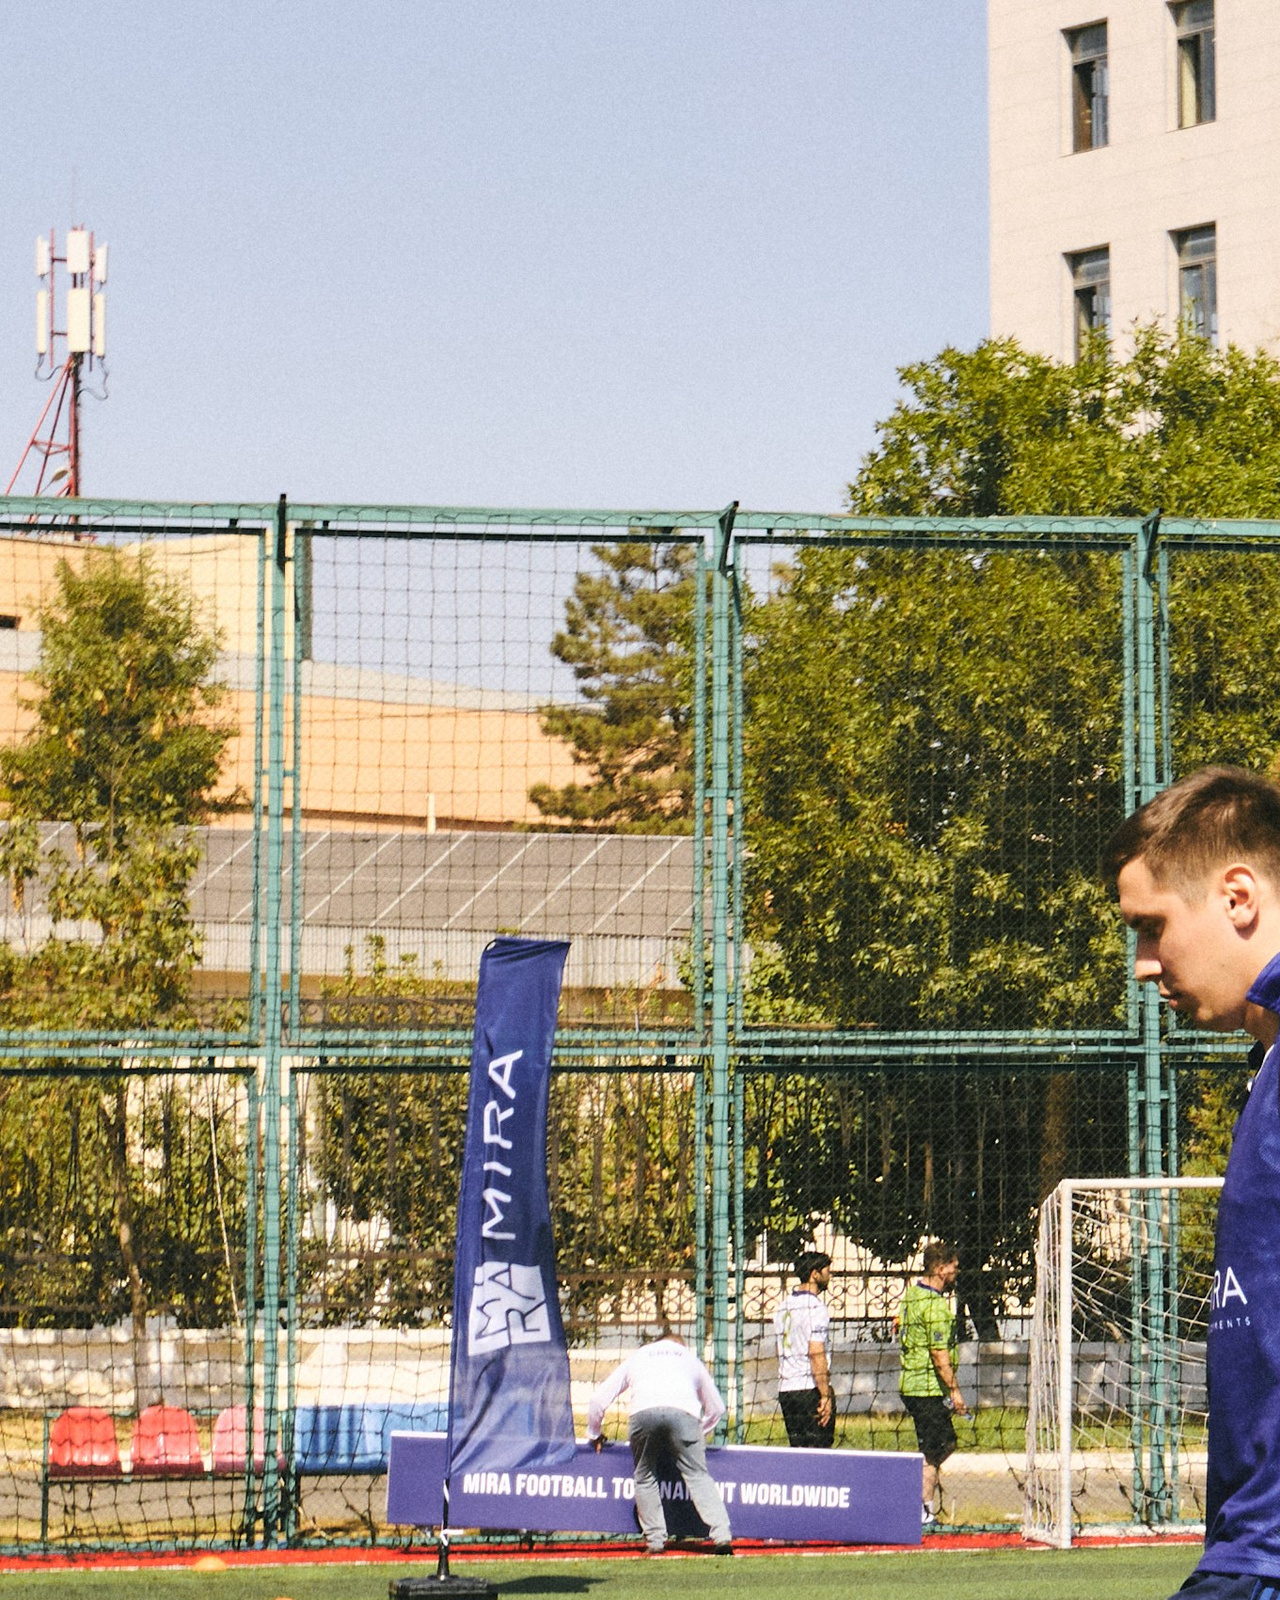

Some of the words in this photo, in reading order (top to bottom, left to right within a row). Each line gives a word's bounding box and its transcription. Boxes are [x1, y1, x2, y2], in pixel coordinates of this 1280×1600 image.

[482, 1050, 523, 1240] MIRA
[1211, 1266, 1248, 1309] RA
[463, 1473, 510, 1495] MIRA
[516, 1474, 607, 1498] FOOTBALL
[741, 1483, 850, 1508] WORLDWIDE
